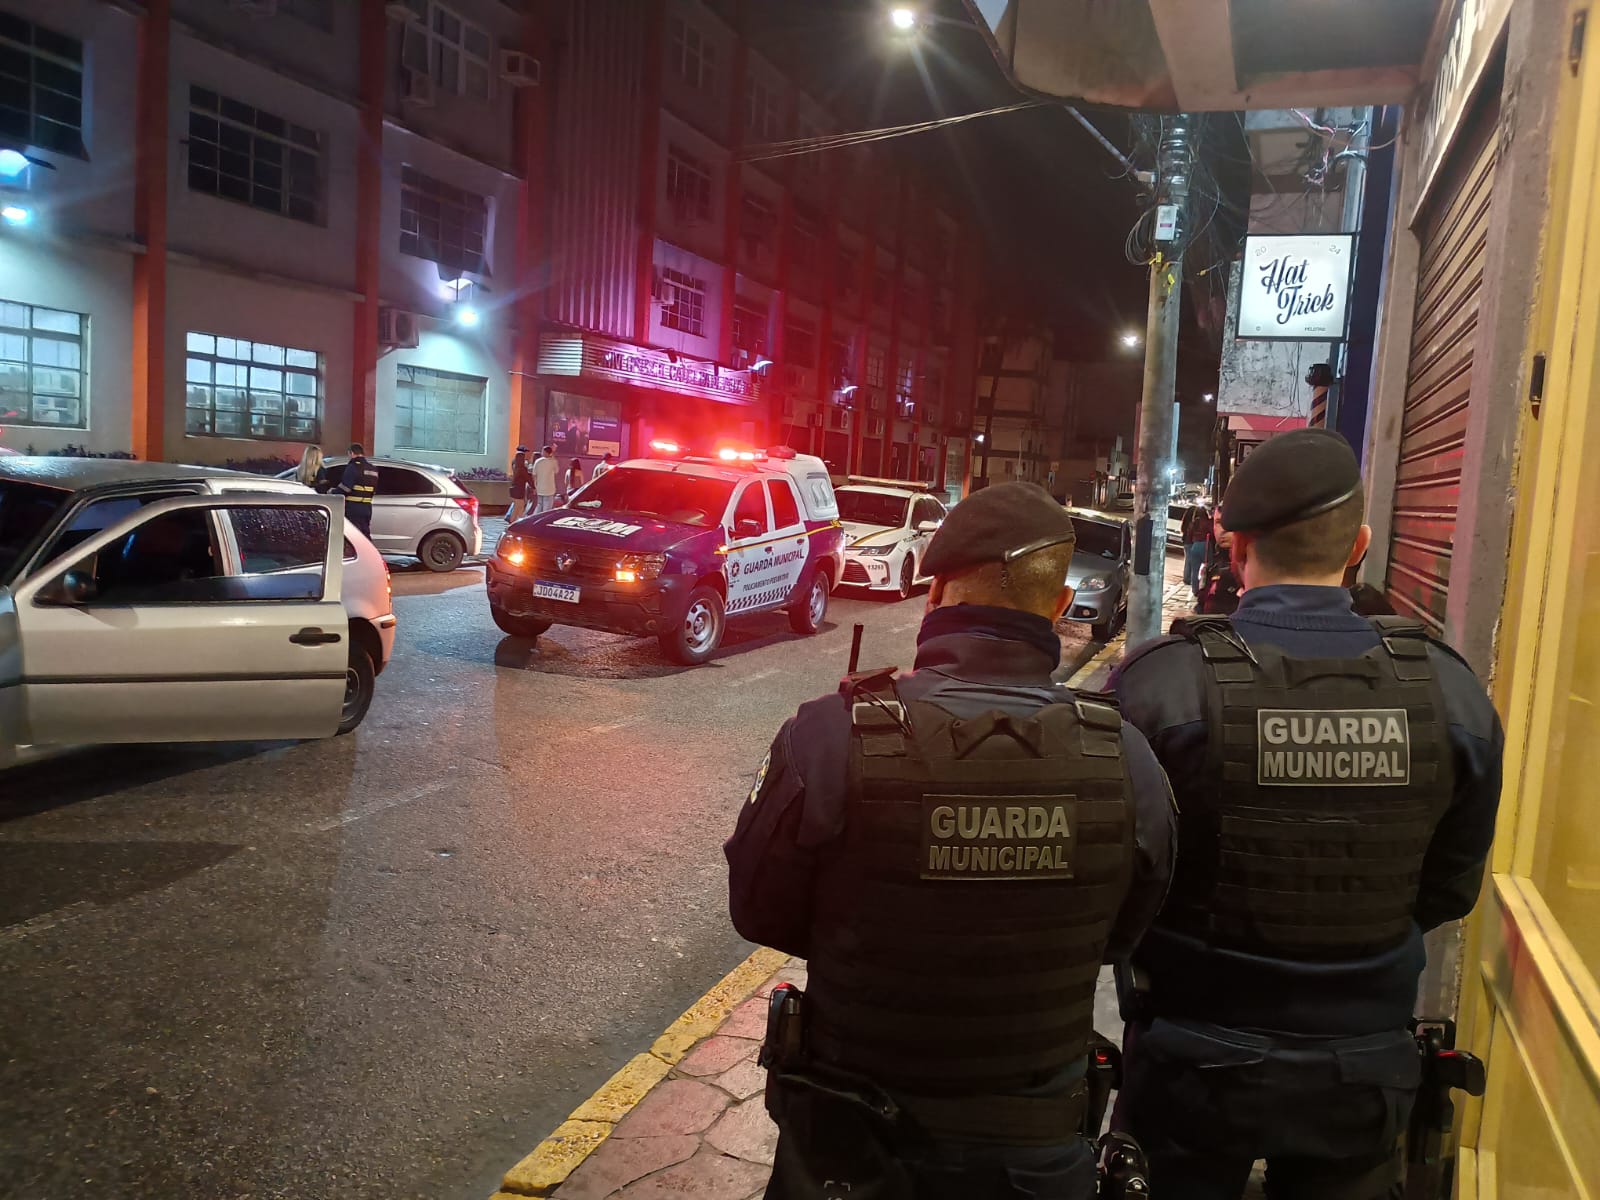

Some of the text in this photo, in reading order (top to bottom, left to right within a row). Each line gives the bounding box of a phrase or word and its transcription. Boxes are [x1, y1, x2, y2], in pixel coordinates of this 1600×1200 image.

[1259, 255, 1309, 294] Hat
[1276, 283, 1334, 324] Trick
[743, 548, 804, 575] GUARDA MUNICIPAL
[1263, 716, 1405, 745] GUARDA
[1263, 750, 1406, 779] MUNICIPAL
[930, 804, 1071, 839] GUARDA
[928, 845, 1069, 871] MUNICIPAL
